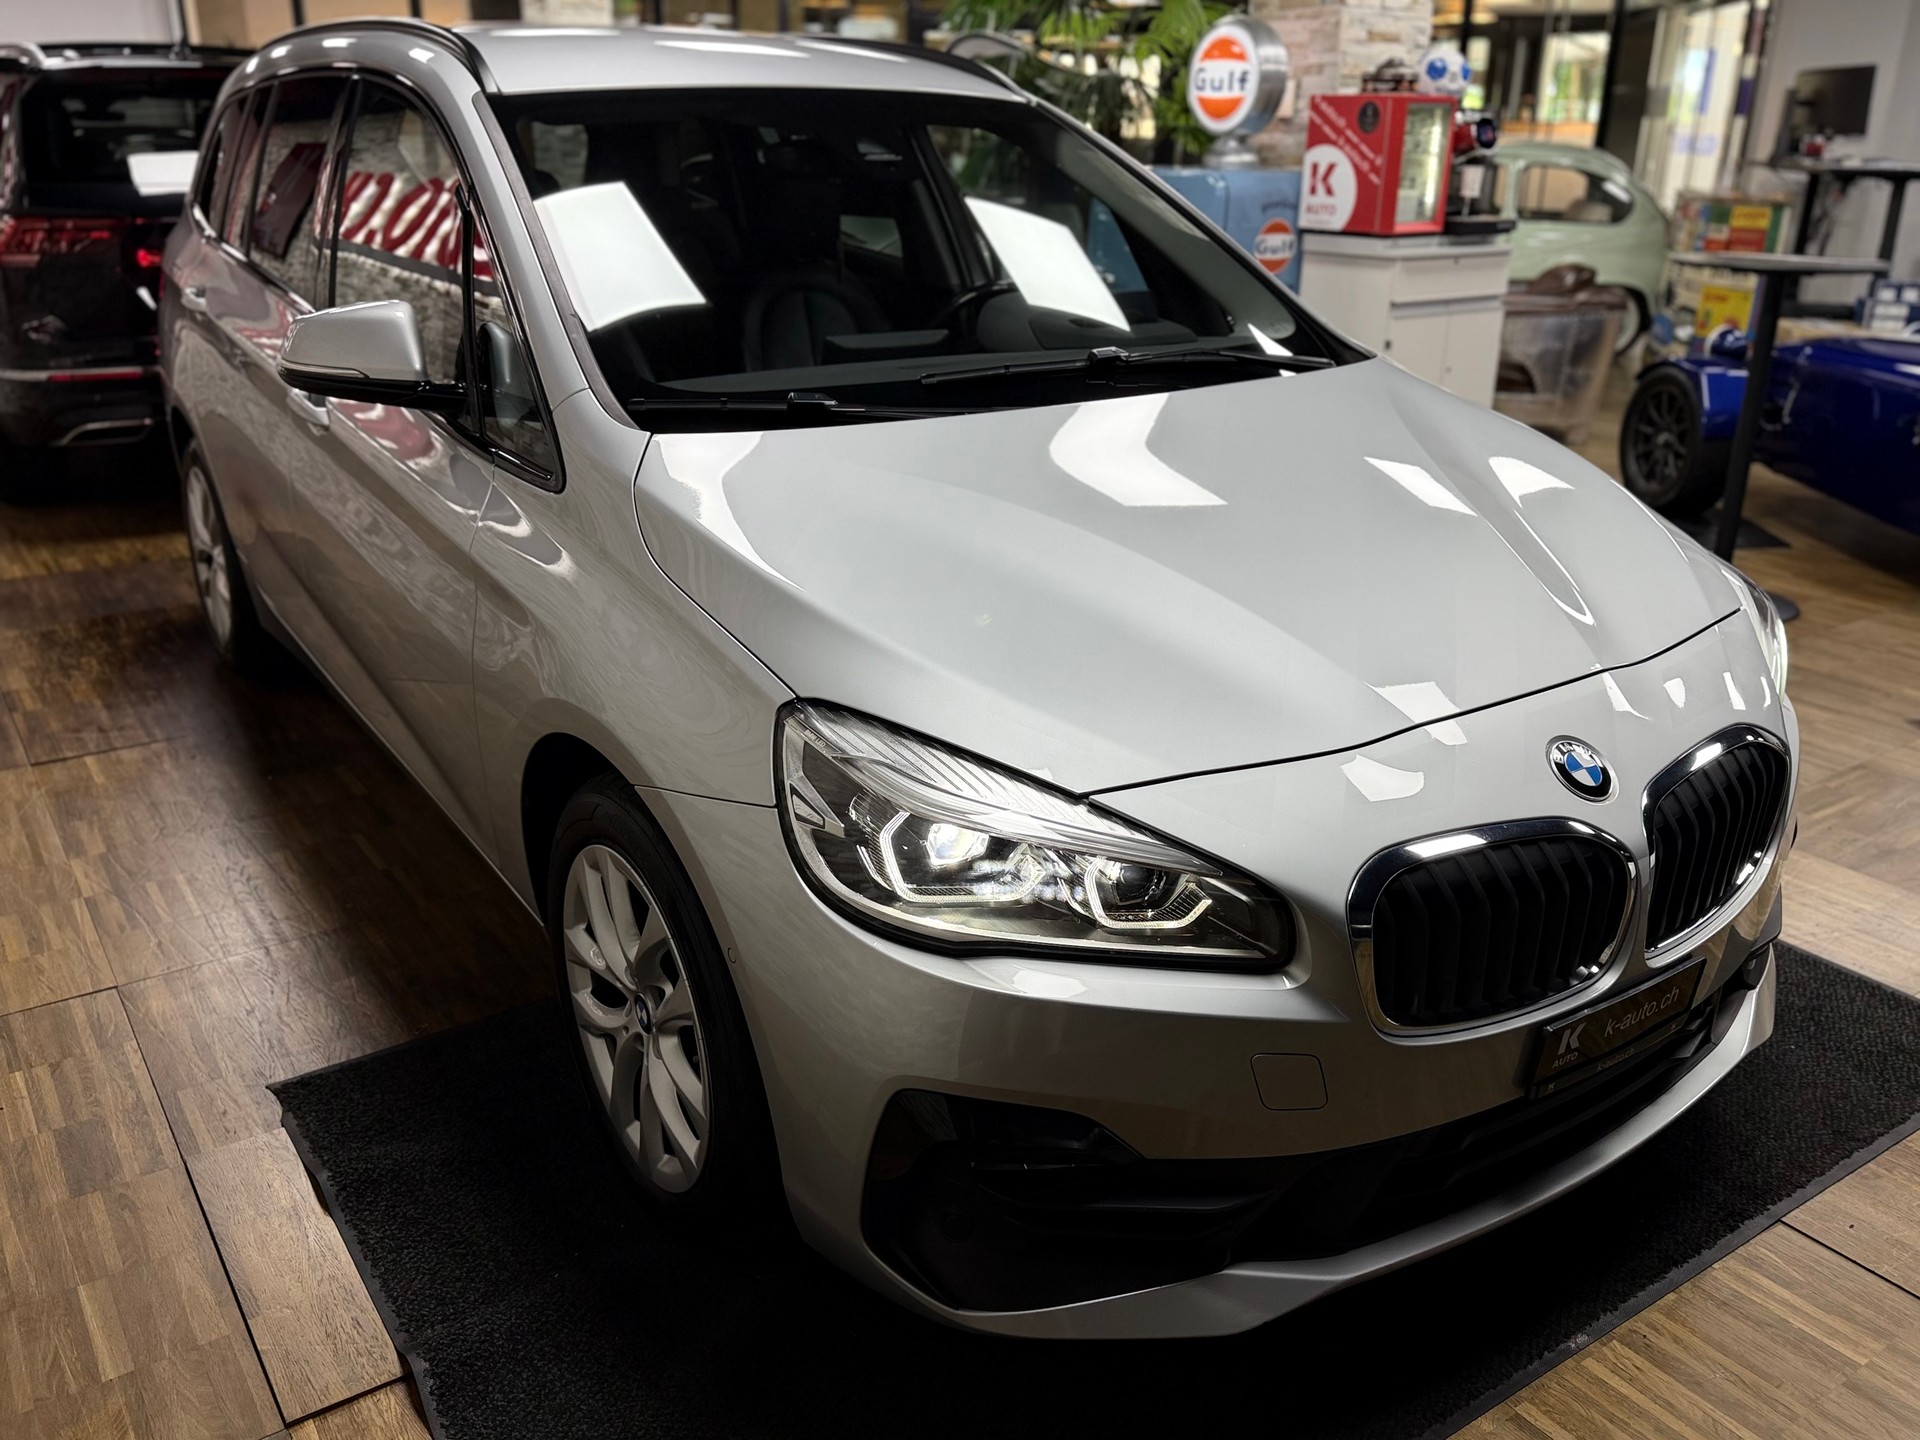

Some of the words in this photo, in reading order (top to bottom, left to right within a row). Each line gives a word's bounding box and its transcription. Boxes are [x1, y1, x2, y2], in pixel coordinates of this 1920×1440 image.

[1194, 66, 1249, 91] Gulf
[1309, 162, 1337, 197] K
[1305, 203, 1337, 217] AUTO
[1255, 238, 1296, 255] Gulf
[804, 729, 817, 741] BMW
[816, 738, 826, 748] LED
[1604, 986, 1680, 1038] k-auto.ch
[1557, 1022, 1587, 1056] K
[1551, 1052, 1578, 1069] AUTO
